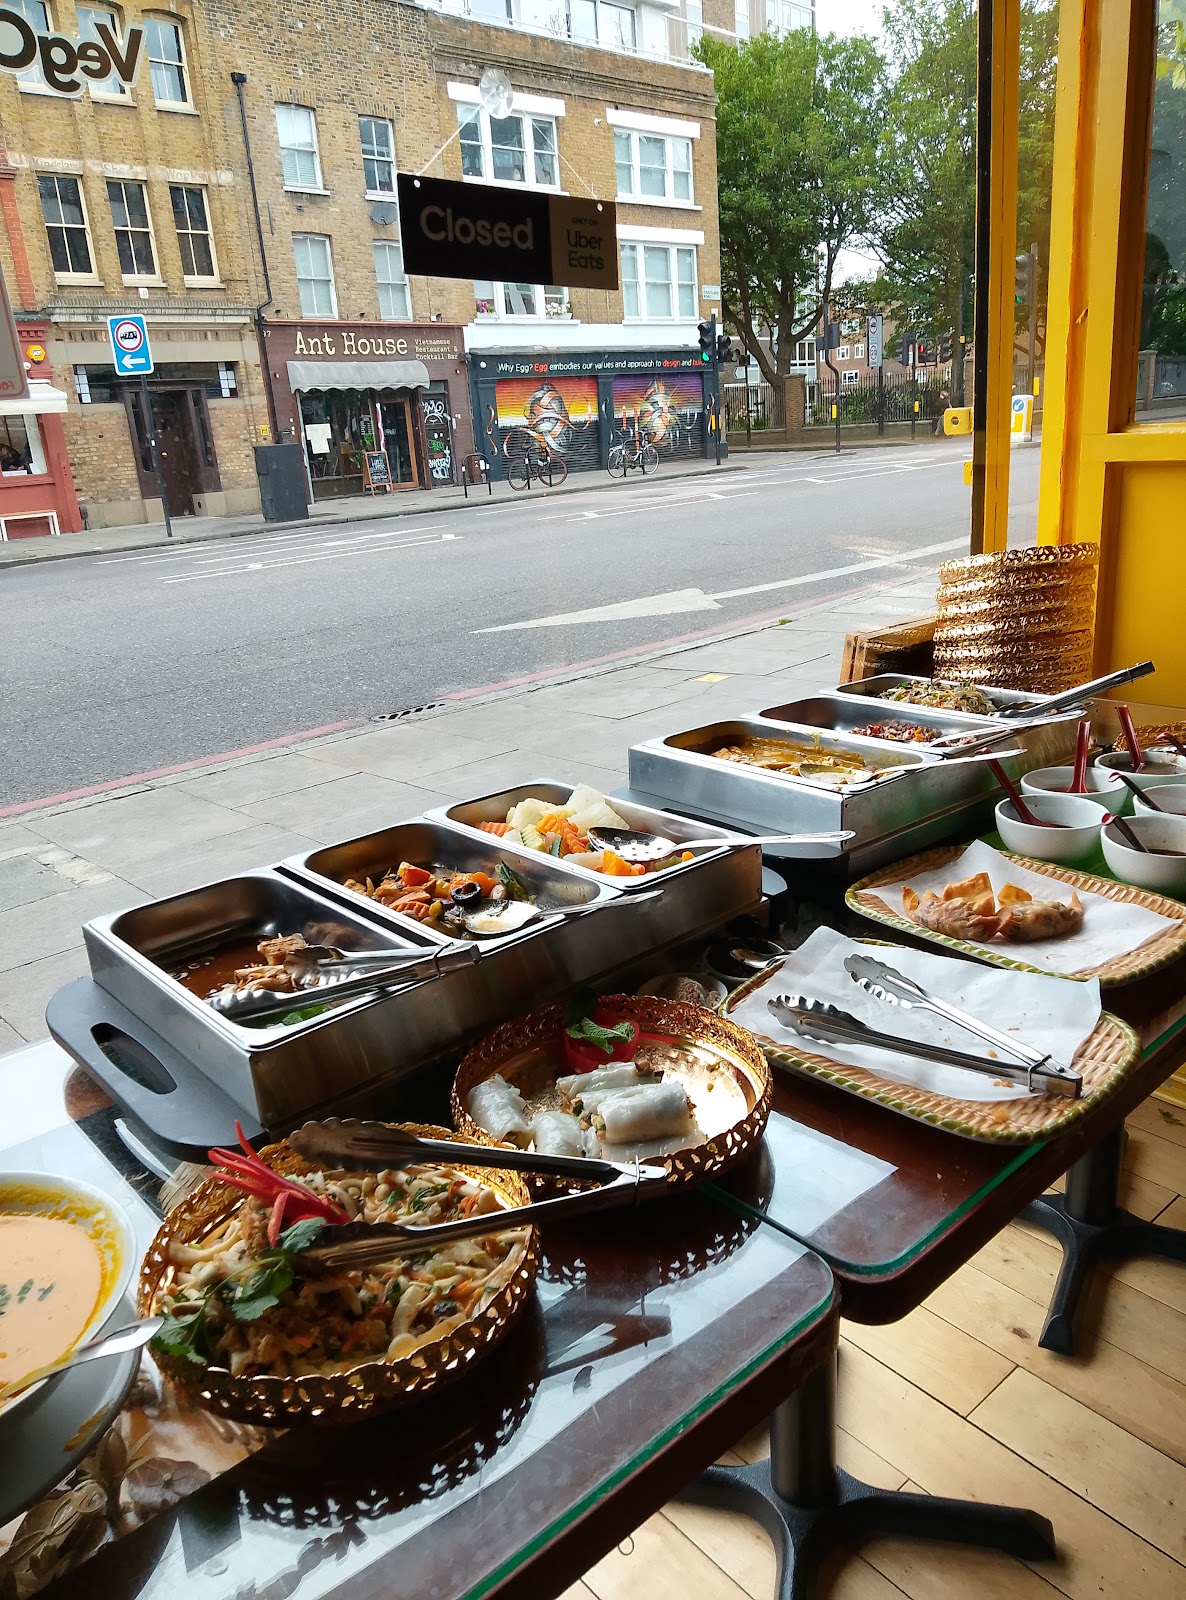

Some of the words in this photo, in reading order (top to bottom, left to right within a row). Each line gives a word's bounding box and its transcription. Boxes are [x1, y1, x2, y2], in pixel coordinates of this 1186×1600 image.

[420, 204, 534, 250] Closed
[567, 229, 604, 250] Uber
[568, 250, 605, 270] Eats
[294, 331, 336, 356] Ant
[341, 332, 408, 355] House
[498, 362, 514, 373] Why
[515, 363, 533, 373] Egg?
[534, 363, 548, 373] Egg
[549, 361, 581, 371] embodies
[594, 361, 614, 371] values
[615, 360, 627, 368] and
[627, 359, 655, 369] approach
[655, 359, 662, 367] to
[662, 359, 681, 368] design
[681, 358, 692, 366] and
